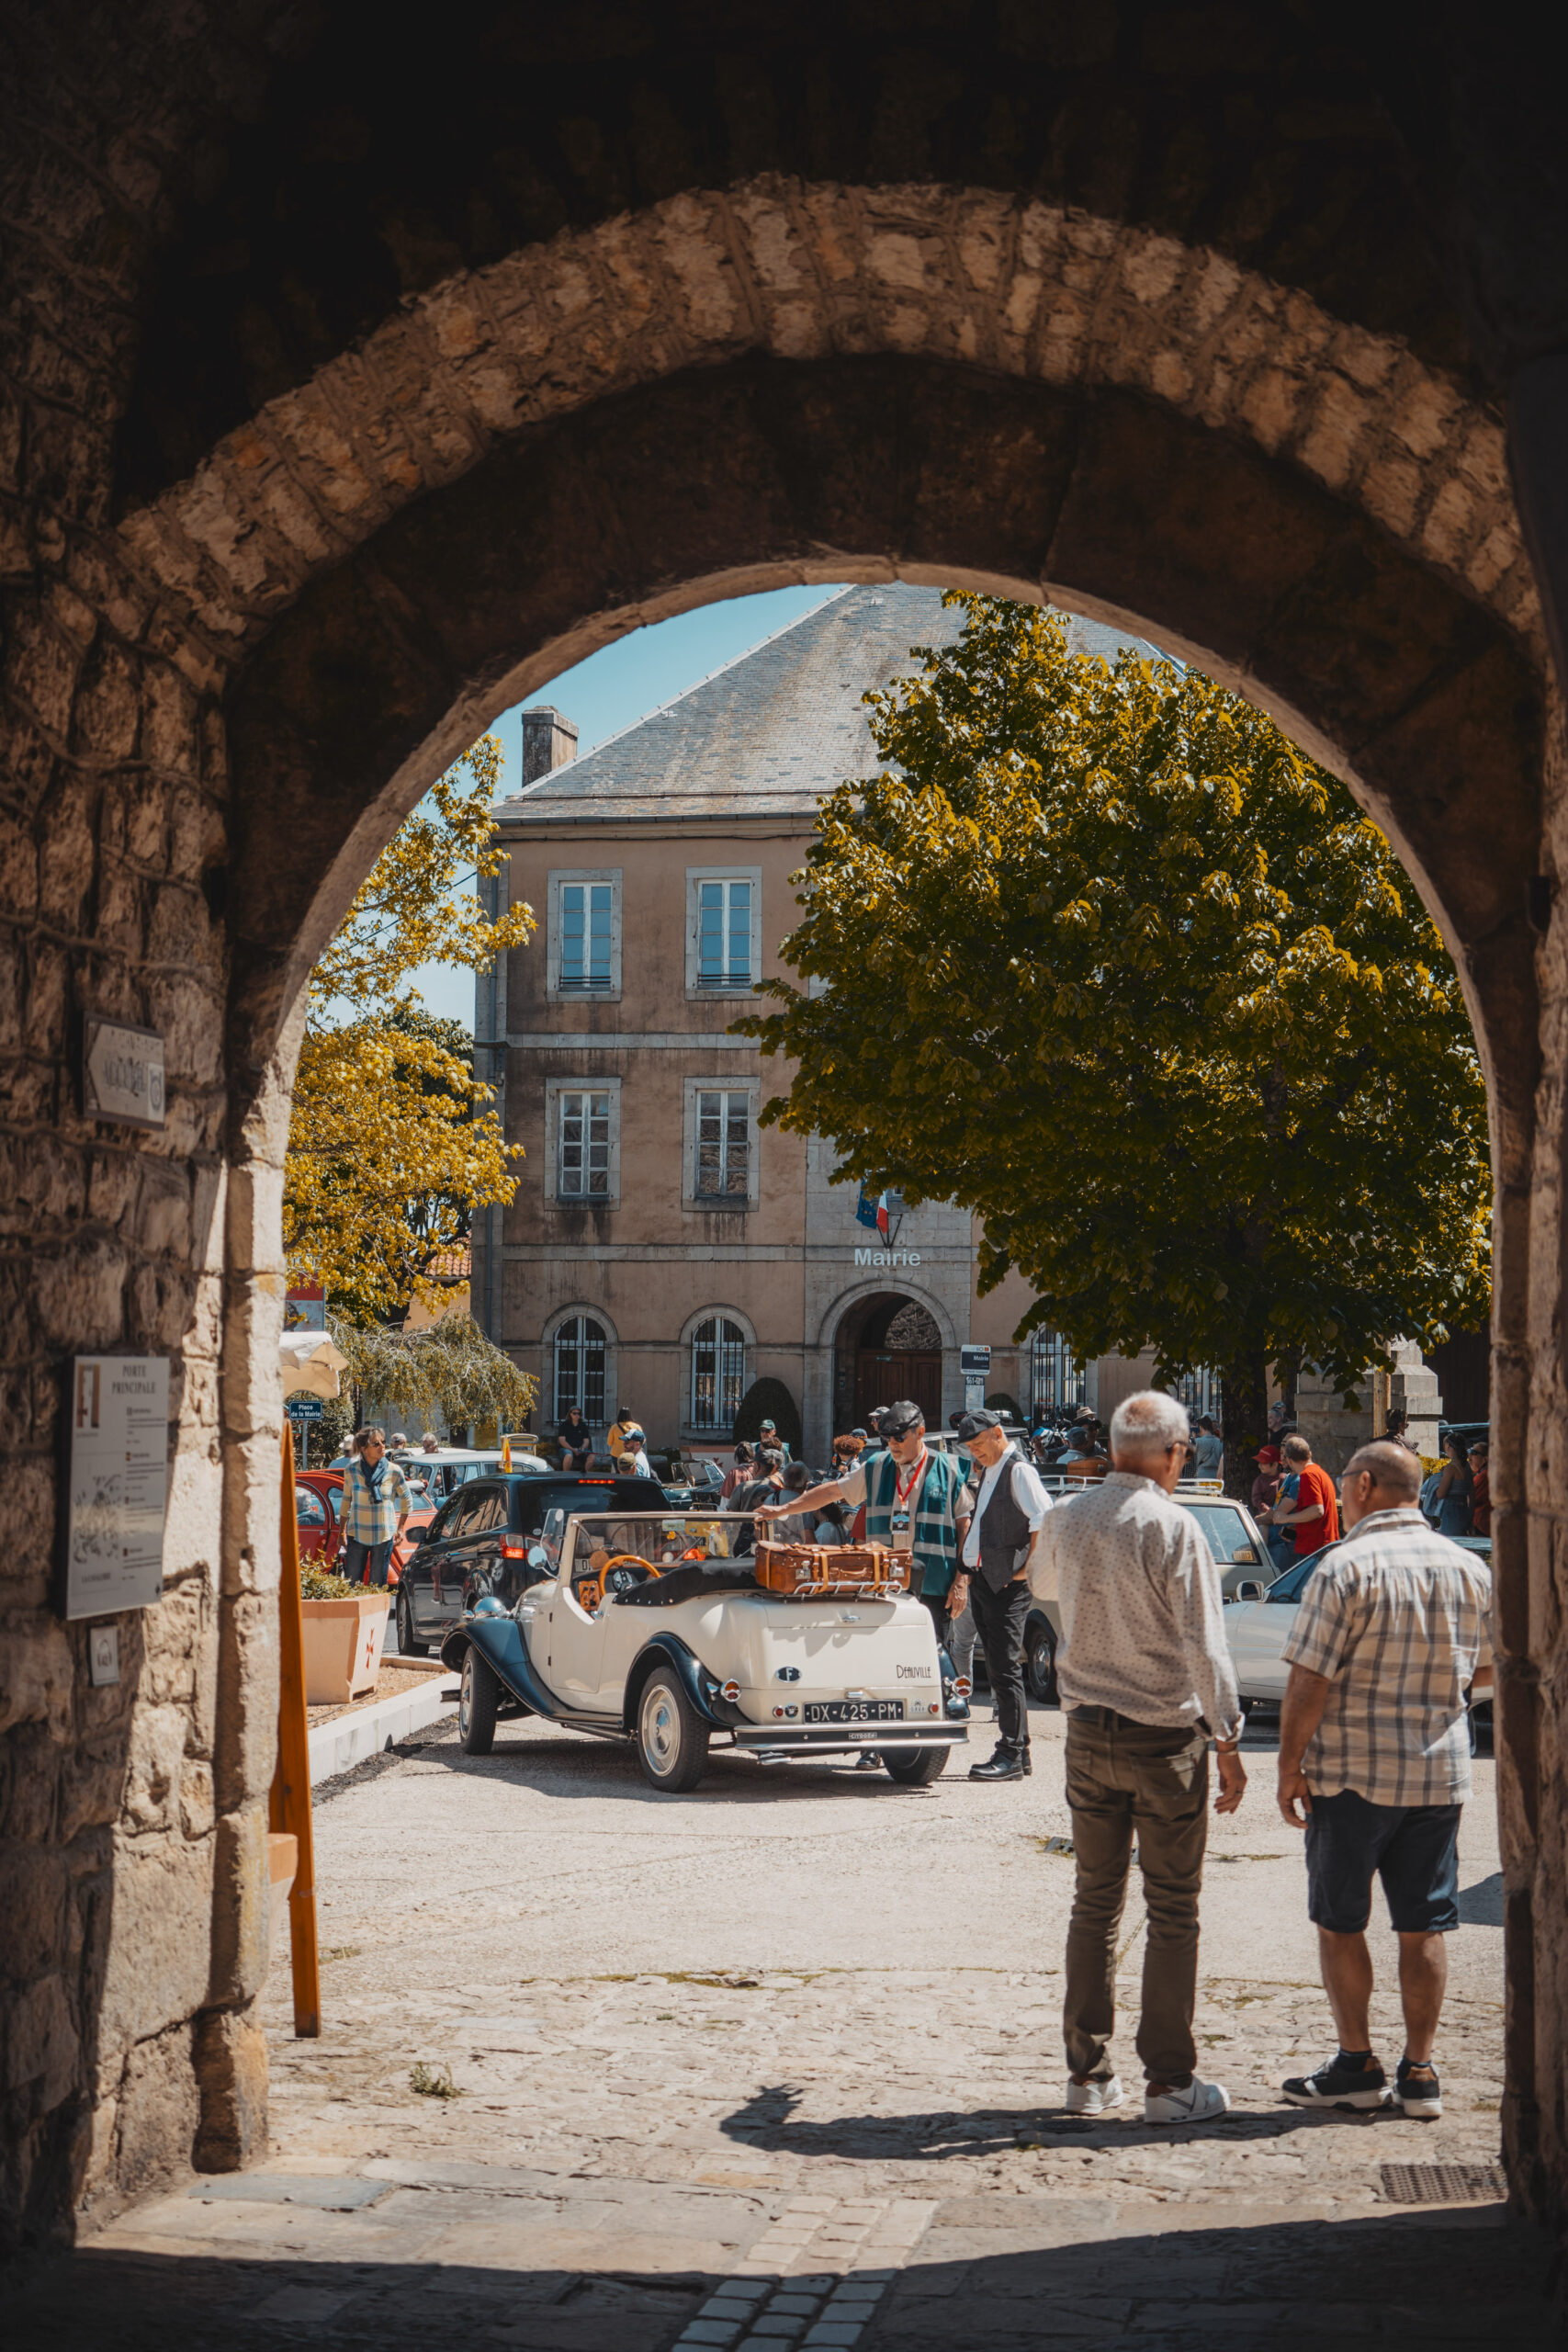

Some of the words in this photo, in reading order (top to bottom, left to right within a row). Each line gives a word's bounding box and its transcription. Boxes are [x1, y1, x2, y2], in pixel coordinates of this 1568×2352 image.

[854, 1248, 921, 1266] Mairie
[122, 1364, 147, 1377] PORTE
[111, 1382, 156, 1394] PRINCIPALE
[786, 1668, 794, 1682] F
[810, 1703, 897, 1722] DX-425-PM
